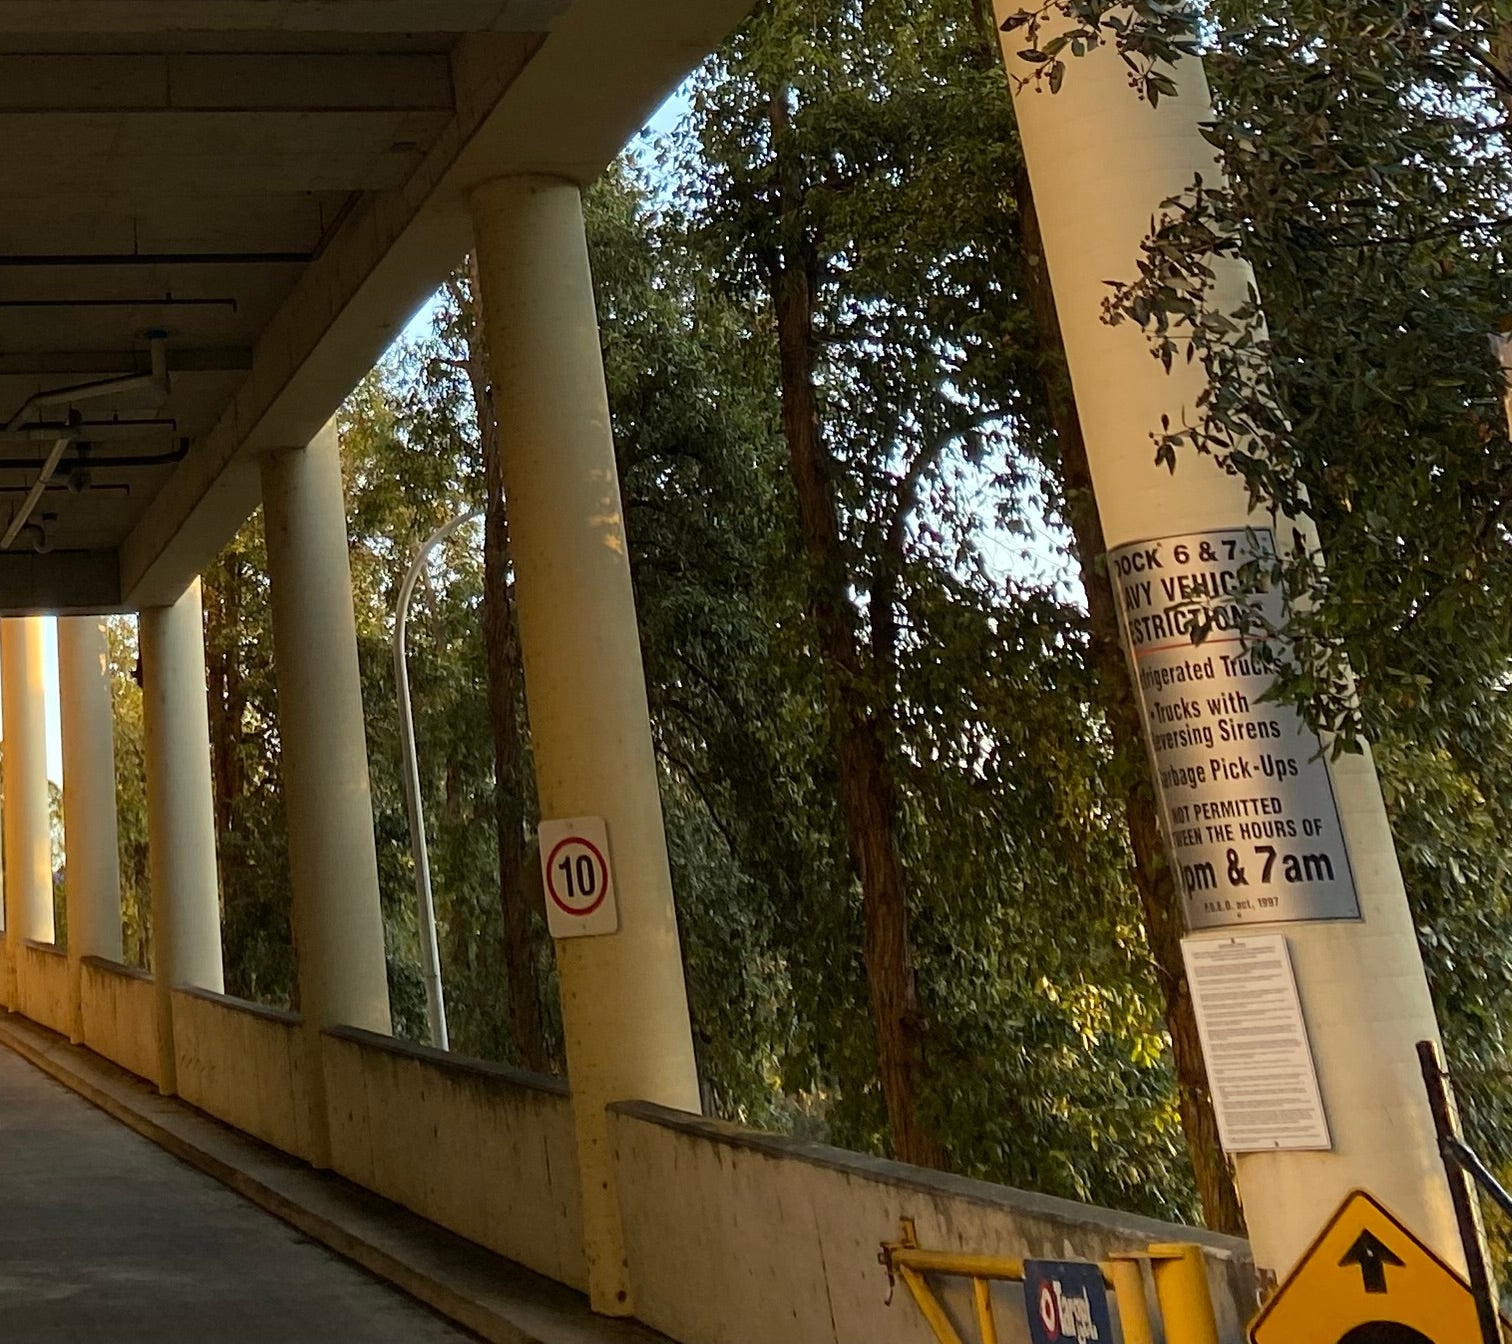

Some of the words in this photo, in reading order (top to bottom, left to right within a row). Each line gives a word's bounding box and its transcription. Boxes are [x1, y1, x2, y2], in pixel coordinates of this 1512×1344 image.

[1174, 543, 1190, 564] 6
[1198, 541, 1219, 562] &
[1221, 540, 1237, 561] 7
[1161, 570, 1268, 603] VEHIC
[1207, 691, 1250, 716] with
[1218, 718, 1281, 742] Sirens
[1209, 754, 1299, 782] Pick-Ups
[1193, 797, 1283, 822] PERMITTED
[1206, 823, 1235, 844] THE
[1239, 819, 1297, 841] HOURS
[1302, 818, 1324, 837] OF
[558, 854, 596, 897] 10
[1179, 859, 1218, 900] pm
[1225, 848, 1249, 887] &
[1257, 896, 1280, 909] 1997
